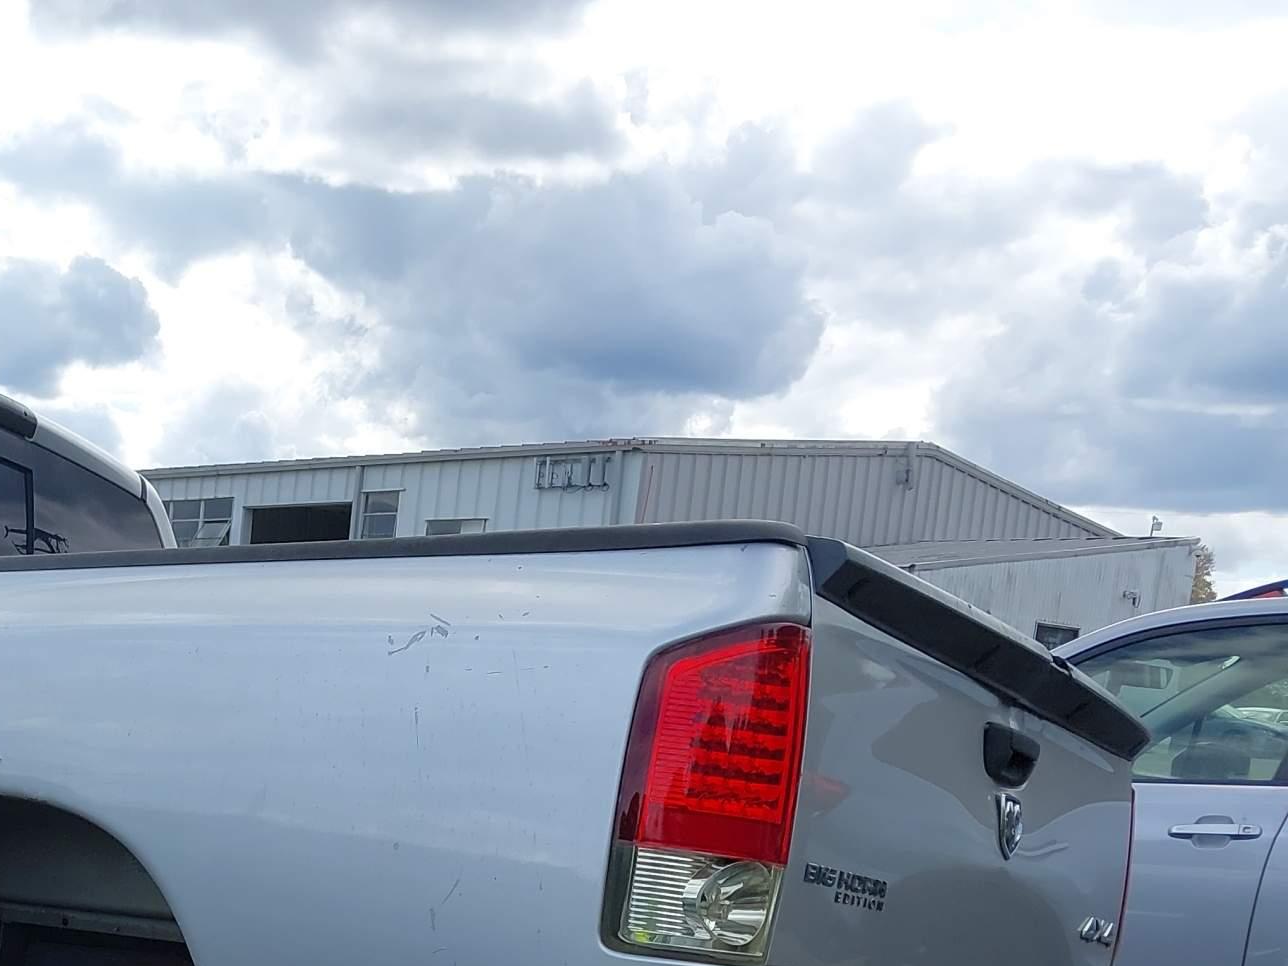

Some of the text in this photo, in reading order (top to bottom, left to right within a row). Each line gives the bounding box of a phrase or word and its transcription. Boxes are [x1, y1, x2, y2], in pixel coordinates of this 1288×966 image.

[804, 862, 887, 898] BIG HORN
[834, 890, 884, 911] EDITION
